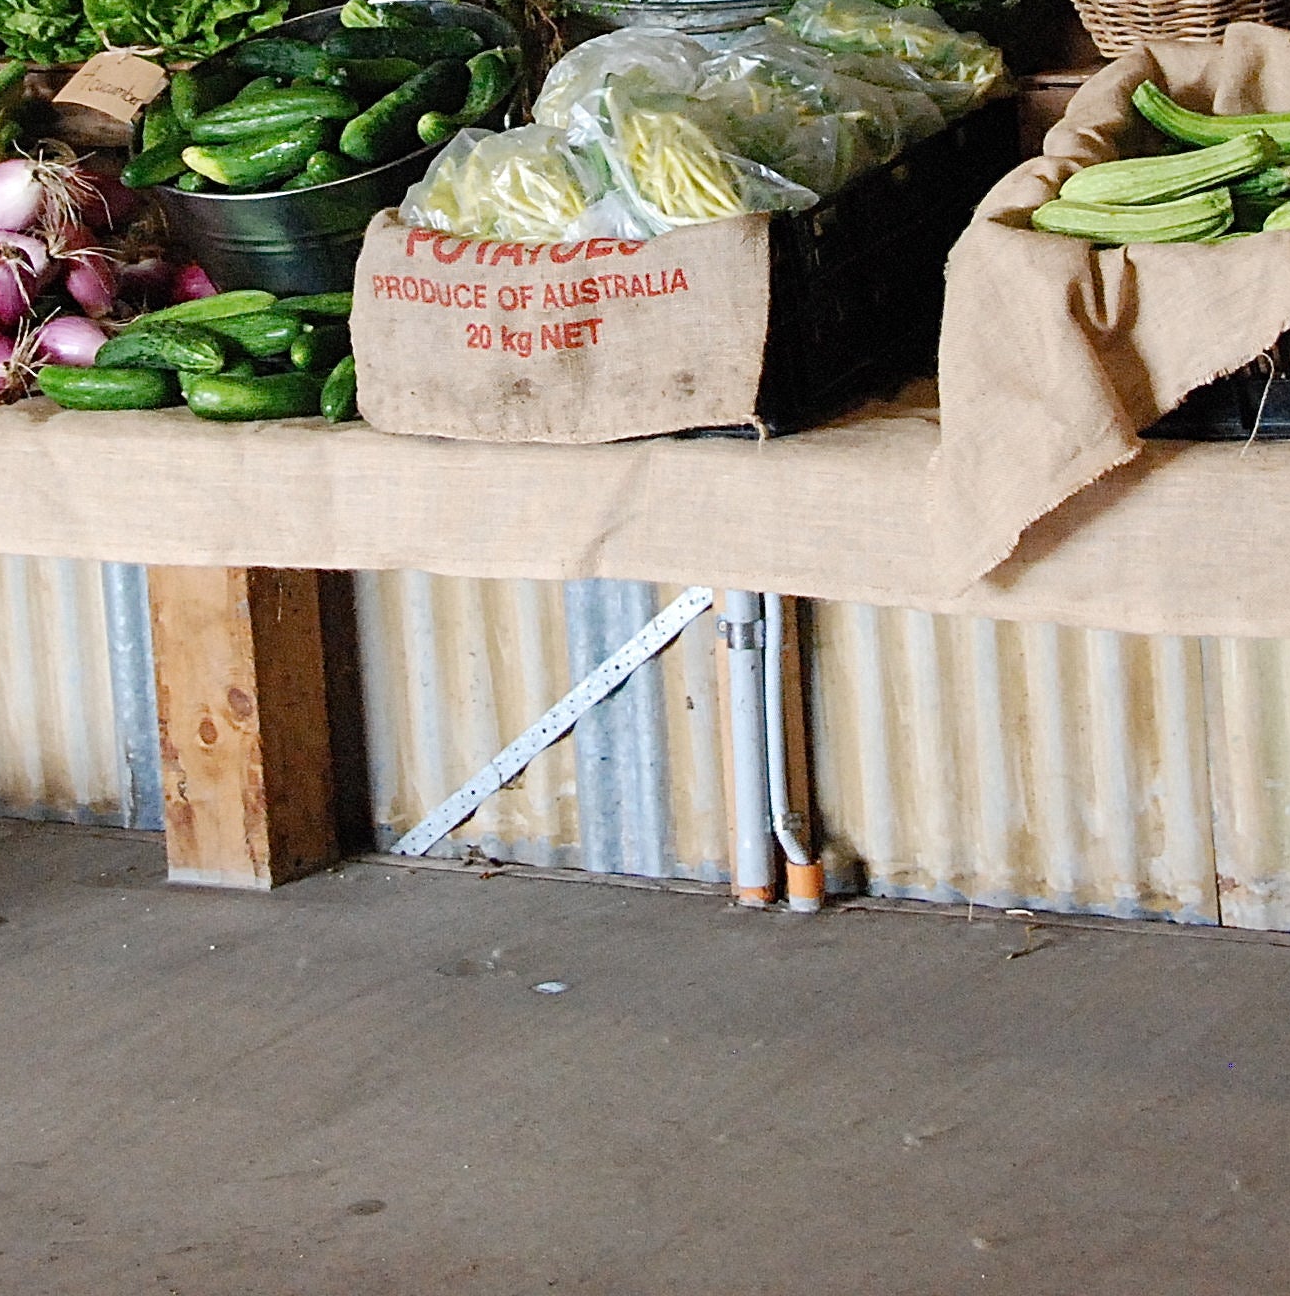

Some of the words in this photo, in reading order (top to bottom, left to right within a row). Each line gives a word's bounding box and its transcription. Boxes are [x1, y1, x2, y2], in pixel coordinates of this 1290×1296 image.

[371, 273, 487, 309] PRODUCE
[497, 284, 534, 311] OF
[542, 267, 689, 310] AUSTRALIA
[465, 322, 493, 350] 20
[501, 324, 533, 358] kg
[540, 317, 603, 351] NET
